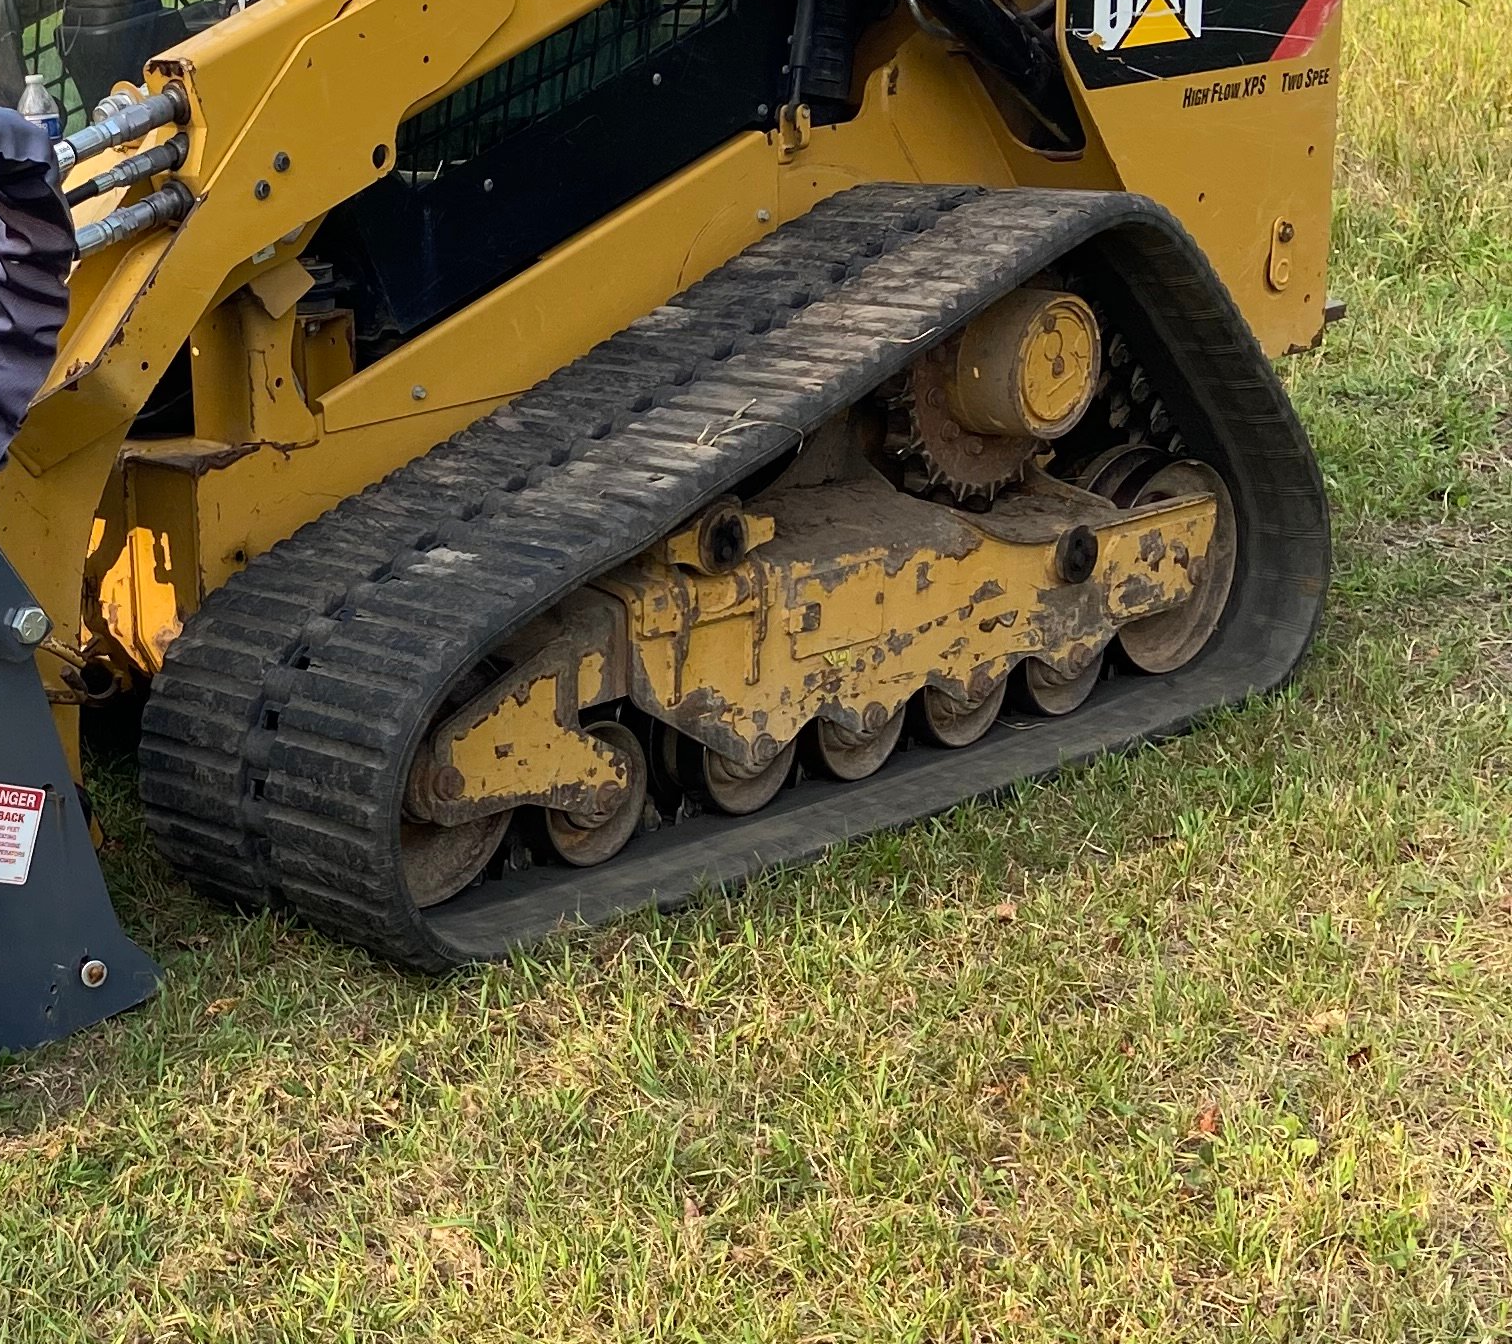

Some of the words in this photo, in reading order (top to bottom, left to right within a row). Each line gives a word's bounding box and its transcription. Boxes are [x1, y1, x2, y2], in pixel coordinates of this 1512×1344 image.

[1182, 86, 1210, 108] HIGH
[1210, 83, 1241, 104] FLOW
[1242, 75, 1267, 98] XPS
[1282, 72, 1303, 92] TWO
